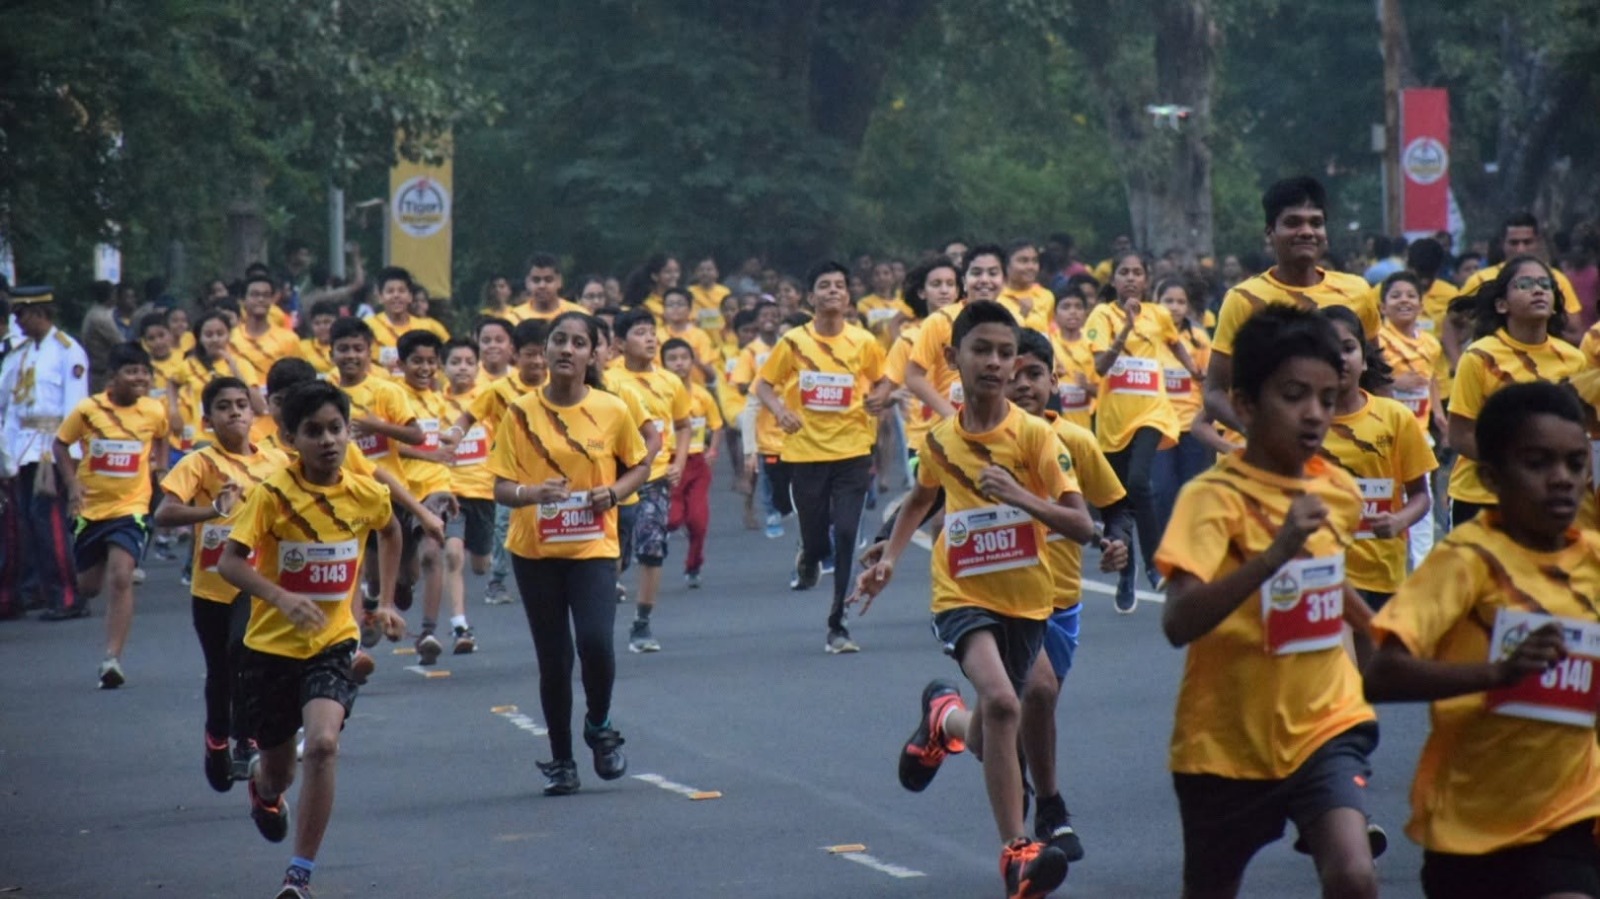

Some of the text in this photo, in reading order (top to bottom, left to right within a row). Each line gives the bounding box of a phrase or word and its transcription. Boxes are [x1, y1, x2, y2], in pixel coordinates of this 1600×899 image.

[561, 510, 594, 527] 3040
[973, 528, 1017, 553] 3067
[309, 564, 347, 583] 3143
